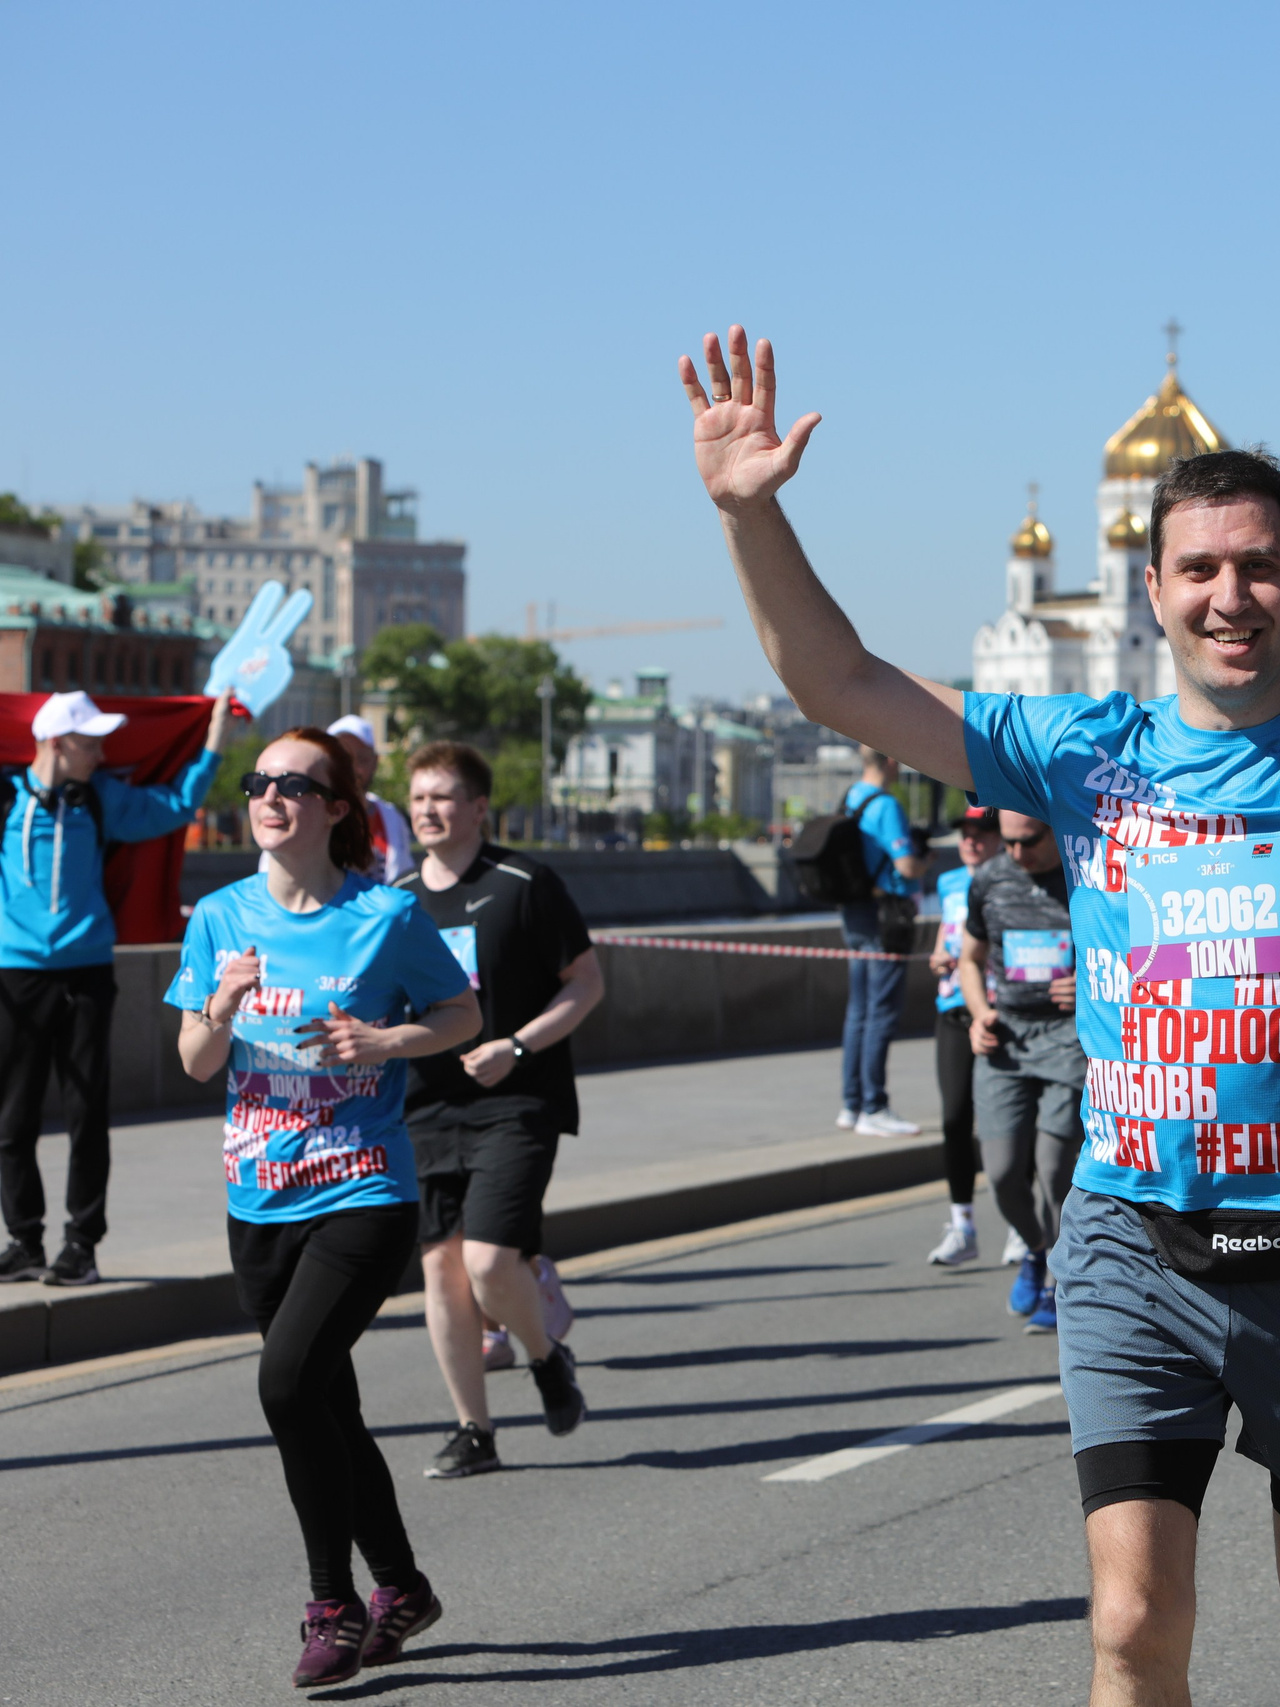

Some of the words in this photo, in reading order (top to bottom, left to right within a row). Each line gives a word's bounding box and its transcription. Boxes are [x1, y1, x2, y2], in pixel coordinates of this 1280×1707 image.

[1083, 745, 1178, 808] 2024
[1152, 853, 1178, 865] ПСБ
[1161, 884, 1279, 937] 32062
[1085, 1057, 1218, 1120] #ЛЮБОВЬ
